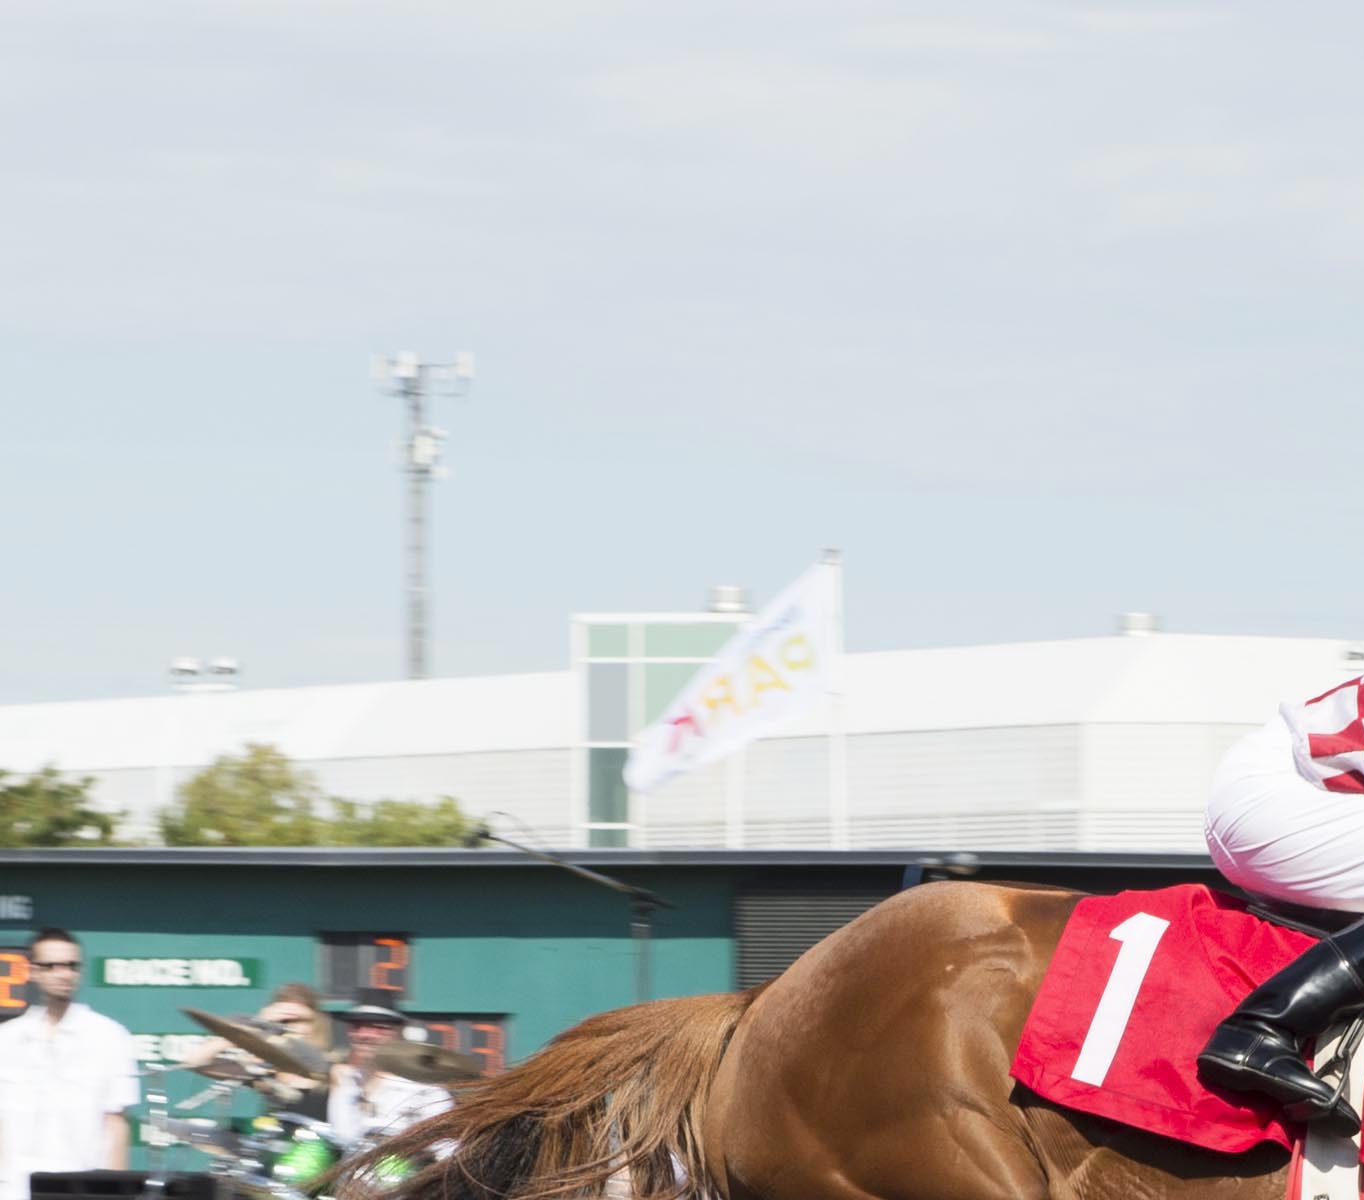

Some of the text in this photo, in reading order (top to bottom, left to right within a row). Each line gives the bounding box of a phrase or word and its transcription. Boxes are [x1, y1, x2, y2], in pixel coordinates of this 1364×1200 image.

[104, 958, 252, 986] RACE NO.
[370, 938, 410, 991] 2
[1070, 911, 1171, 1088] 1
